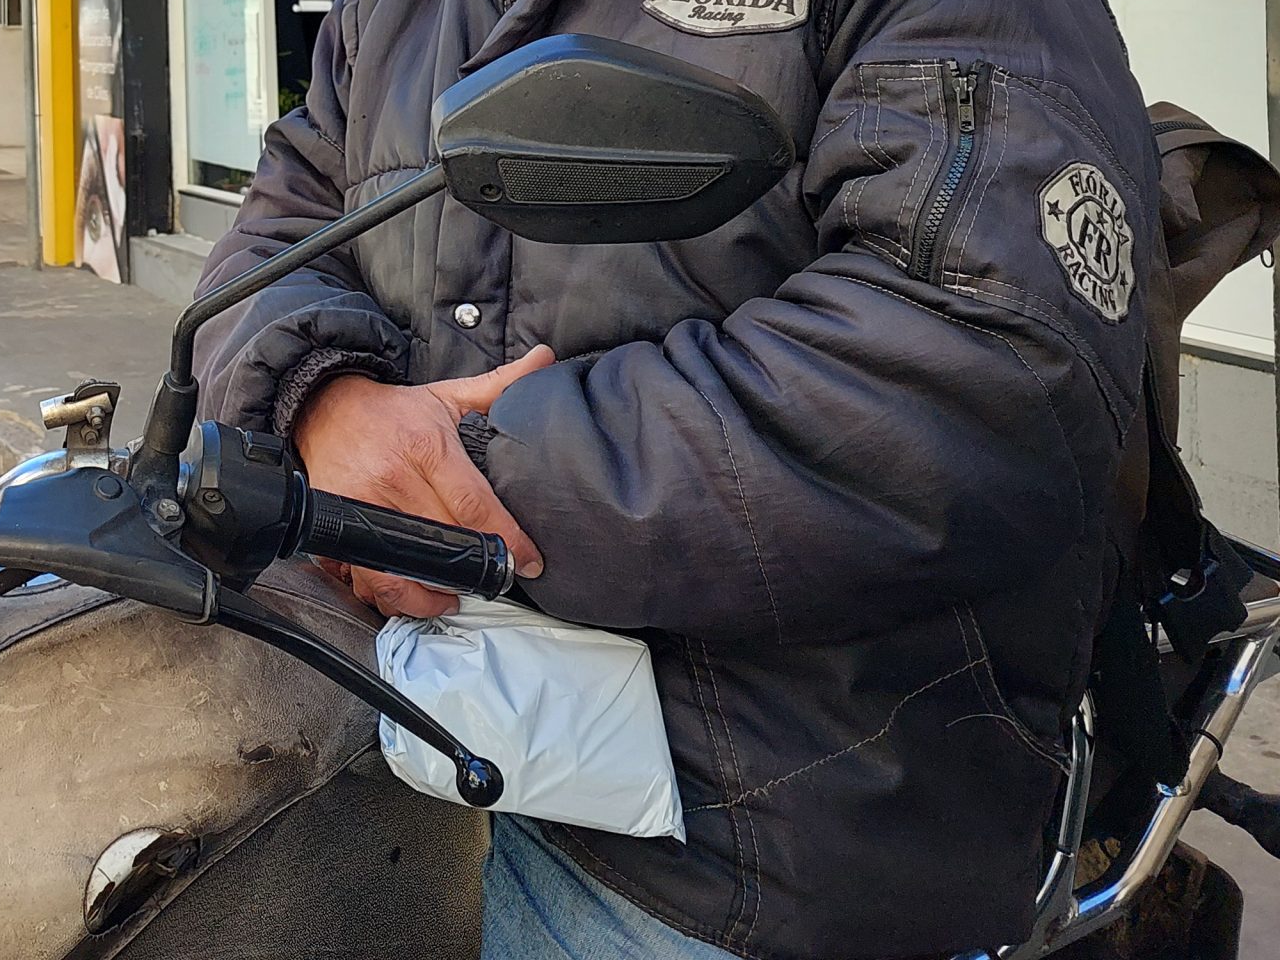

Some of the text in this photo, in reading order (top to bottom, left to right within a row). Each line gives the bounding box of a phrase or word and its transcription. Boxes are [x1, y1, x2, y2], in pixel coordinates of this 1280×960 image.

[687, 5, 746, 26] Racing
[1067, 170, 1132, 247] FLÓRIDA
[1056, 241, 1118, 314] RACING
[1076, 213, 1113, 278] FR
